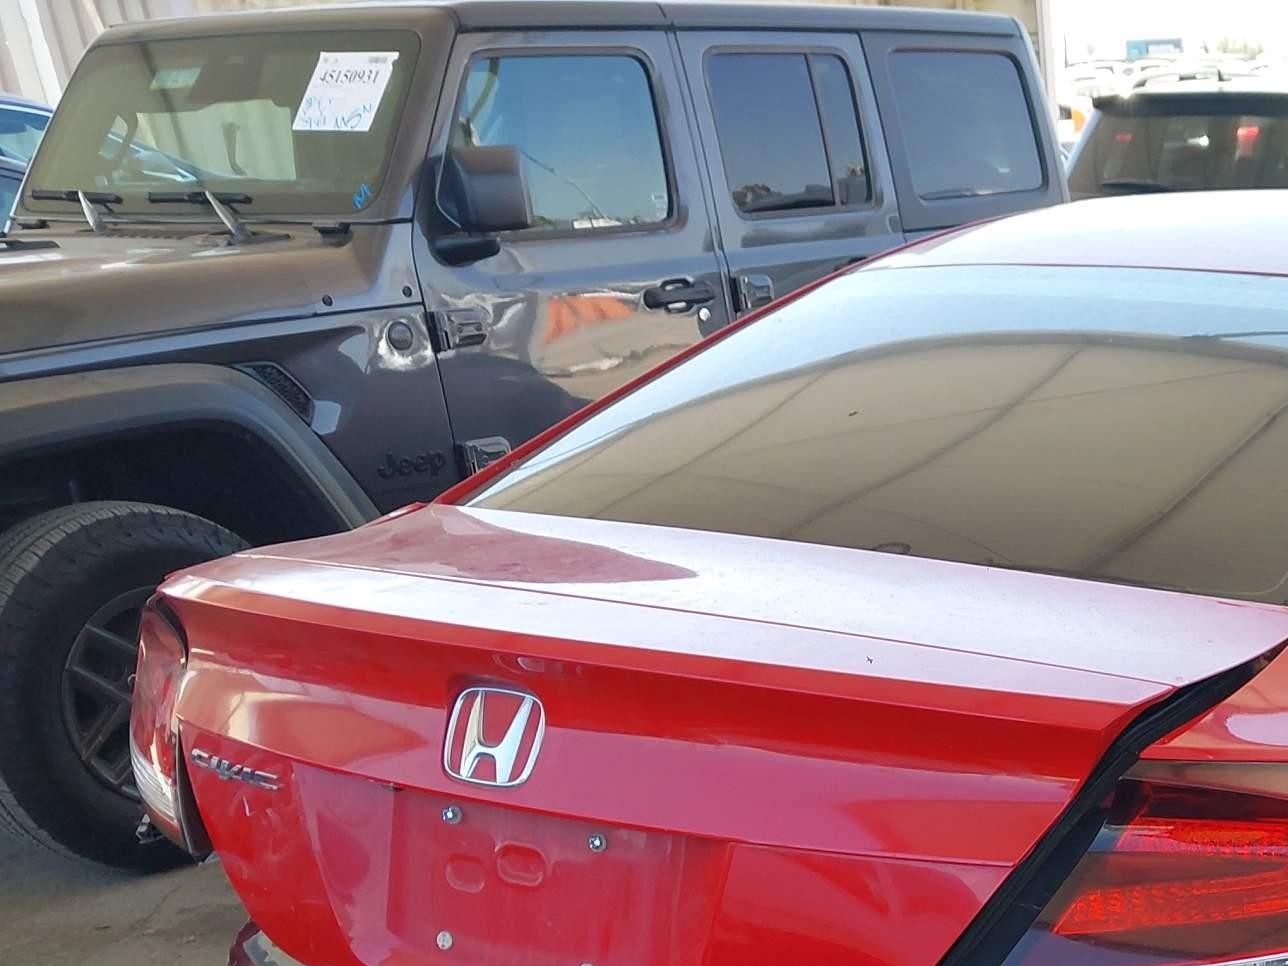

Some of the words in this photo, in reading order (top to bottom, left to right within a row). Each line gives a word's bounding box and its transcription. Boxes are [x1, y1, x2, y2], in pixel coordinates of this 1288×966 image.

[319, 69, 380, 84] 45150931
[377, 450, 446, 479] Jeep
[191, 748, 279, 790] CIVIC
